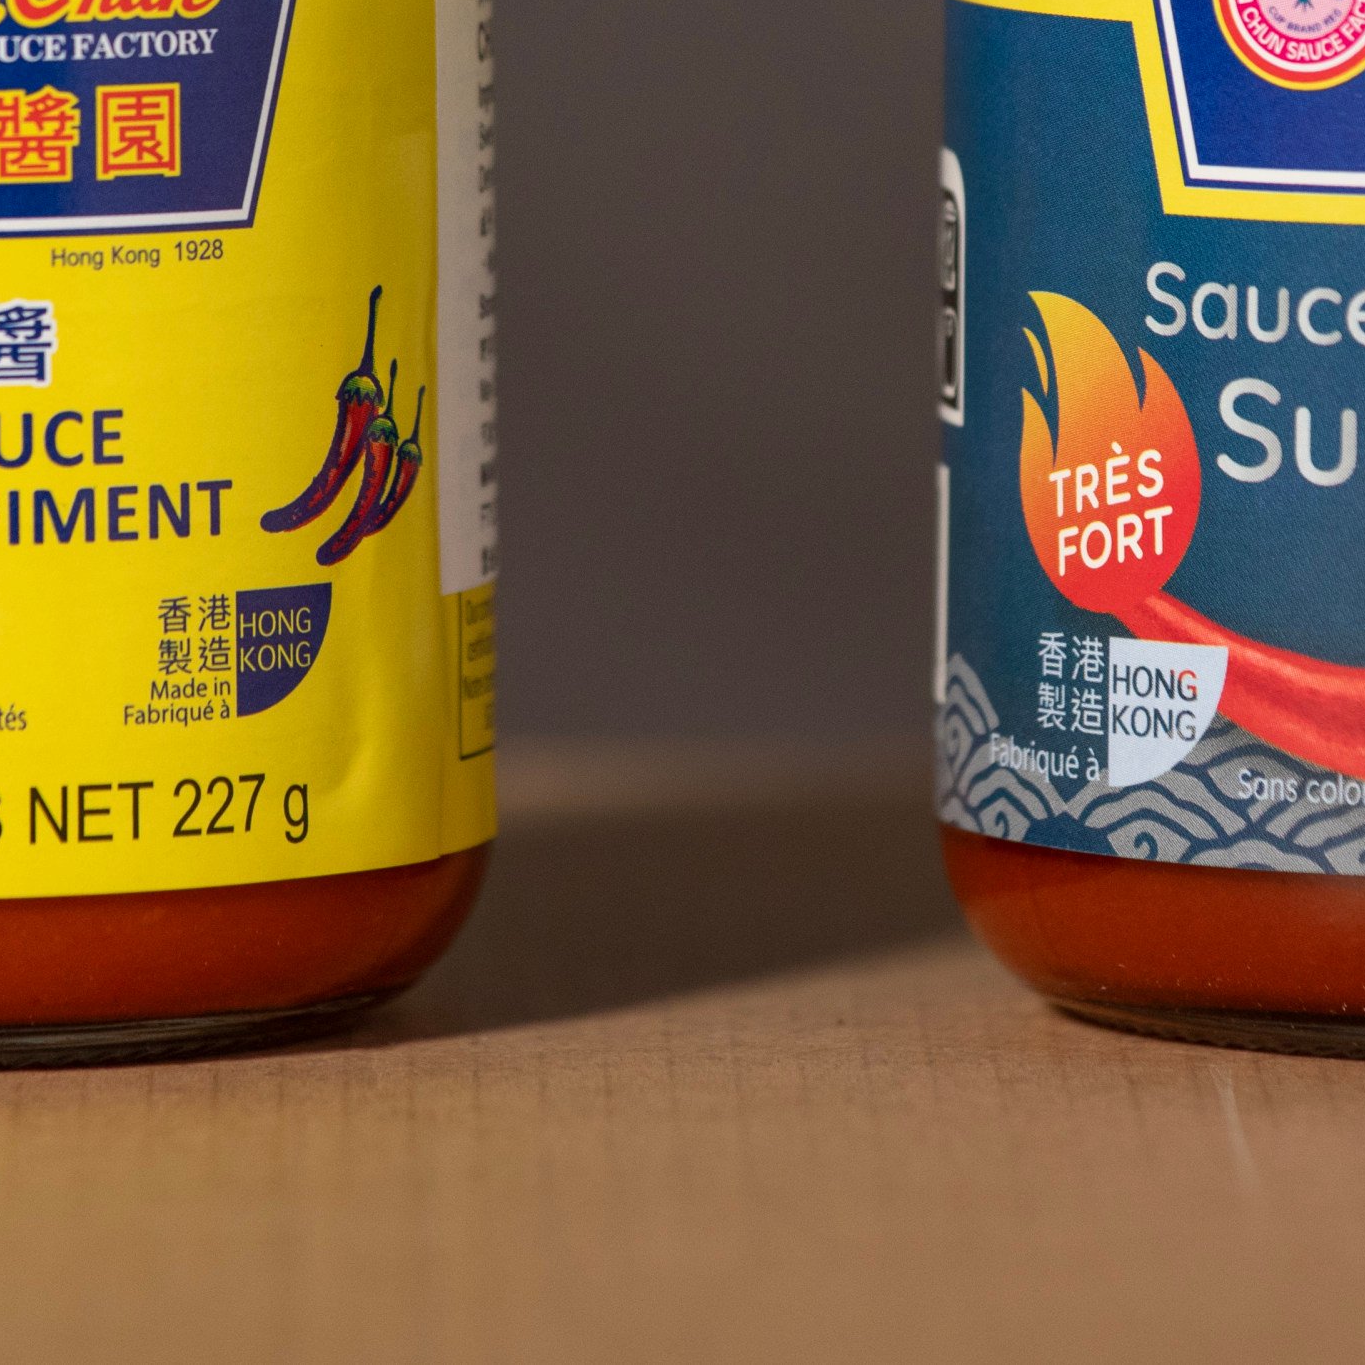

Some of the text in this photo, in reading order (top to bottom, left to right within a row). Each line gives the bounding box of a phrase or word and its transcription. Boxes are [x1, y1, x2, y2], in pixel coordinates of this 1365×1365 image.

[71, 28, 220, 62] FACTORY
[1242, 6, 1287, 56] CHUN
[1285, 36, 1347, 62] SAUCE
[51, 238, 225, 272] Hong Kong 1928
[1049, 440, 1166, 521] TRÈS
[1056, 505, 1174, 577] FORT
[158, 593, 232, 634] 香港
[239, 607, 312, 638] HONG
[158, 636, 232, 676] 製造
[239, 641, 312, 673] KONG
[1037, 631, 1105, 685] 香港
[150, 677, 231, 702] Made in
[1112, 663, 1198, 702] HONG
[123, 700, 231, 727] Fabriqué à
[1036, 681, 1105, 736] 製造
[1111, 702, 1197, 742] KONG
[989, 732, 1101, 784] Fabriqué à
[1236, 768, 1298, 803] Sans
[29, 781, 154, 844] NET
[172, 773, 266, 838] 227
[283, 780, 310, 844] g
